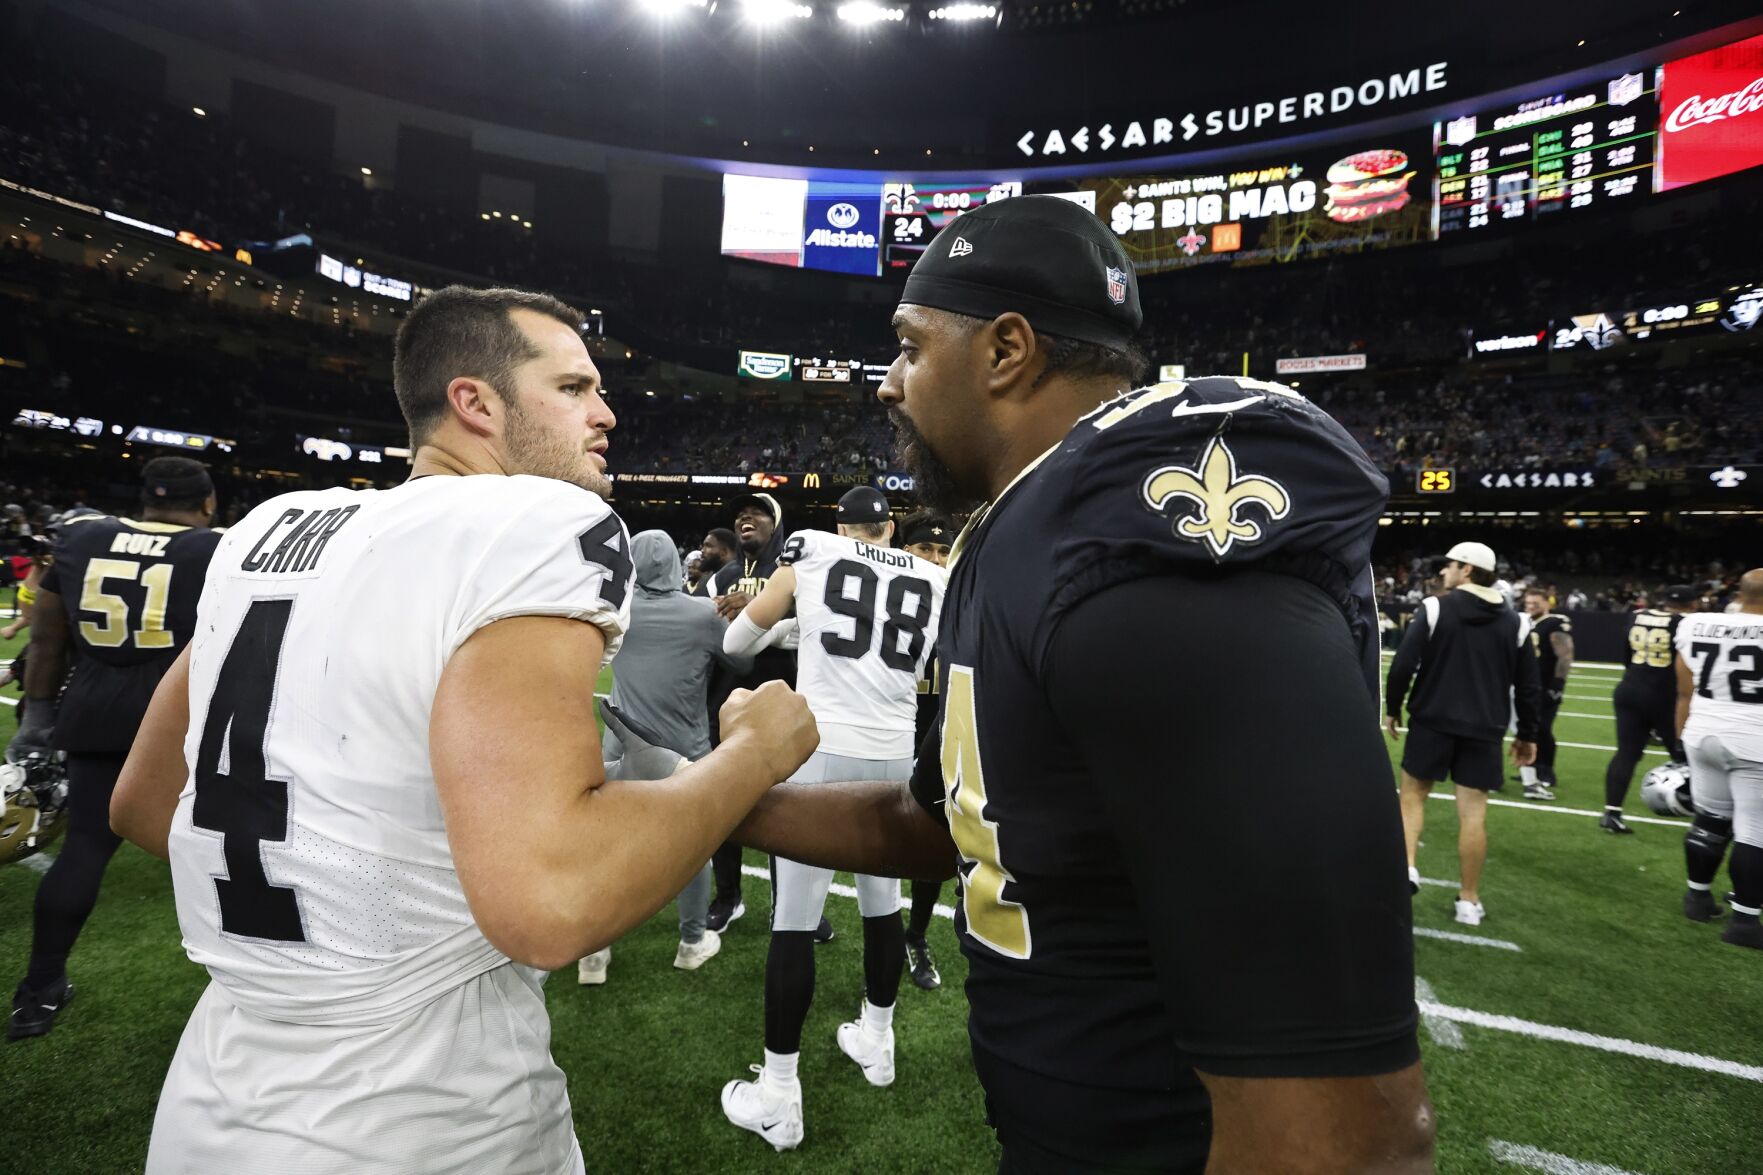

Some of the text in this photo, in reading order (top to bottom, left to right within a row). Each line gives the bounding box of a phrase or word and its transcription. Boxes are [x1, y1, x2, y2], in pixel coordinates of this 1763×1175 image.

[1017, 62, 1448, 156] CAESARS SUPERDOME
[1138, 179, 1191, 198] SAINTS
[1229, 170, 1258, 188] YOU
[1258, 166, 1289, 184] WIN
[933, 193, 970, 208] 0:00
[1111, 180, 1316, 235] $2 BIG MAC
[894, 217, 923, 237] 24
[1109, 282, 1125, 300] NFL
[1475, 334, 1538, 352] verizon
[832, 474, 869, 483] SAINTS
[1421, 470, 1450, 489] 25
[1480, 472, 1594, 488] CAESARS
[110, 532, 171, 556] RUIZ
[241, 504, 361, 573] CARR
[577, 510, 634, 611] 4
[855, 541, 914, 570] CROSBY
[79, 558, 174, 648] 51
[820, 558, 932, 673] 98
[1691, 642, 1763, 704] 72
[191, 596, 309, 945] 4
